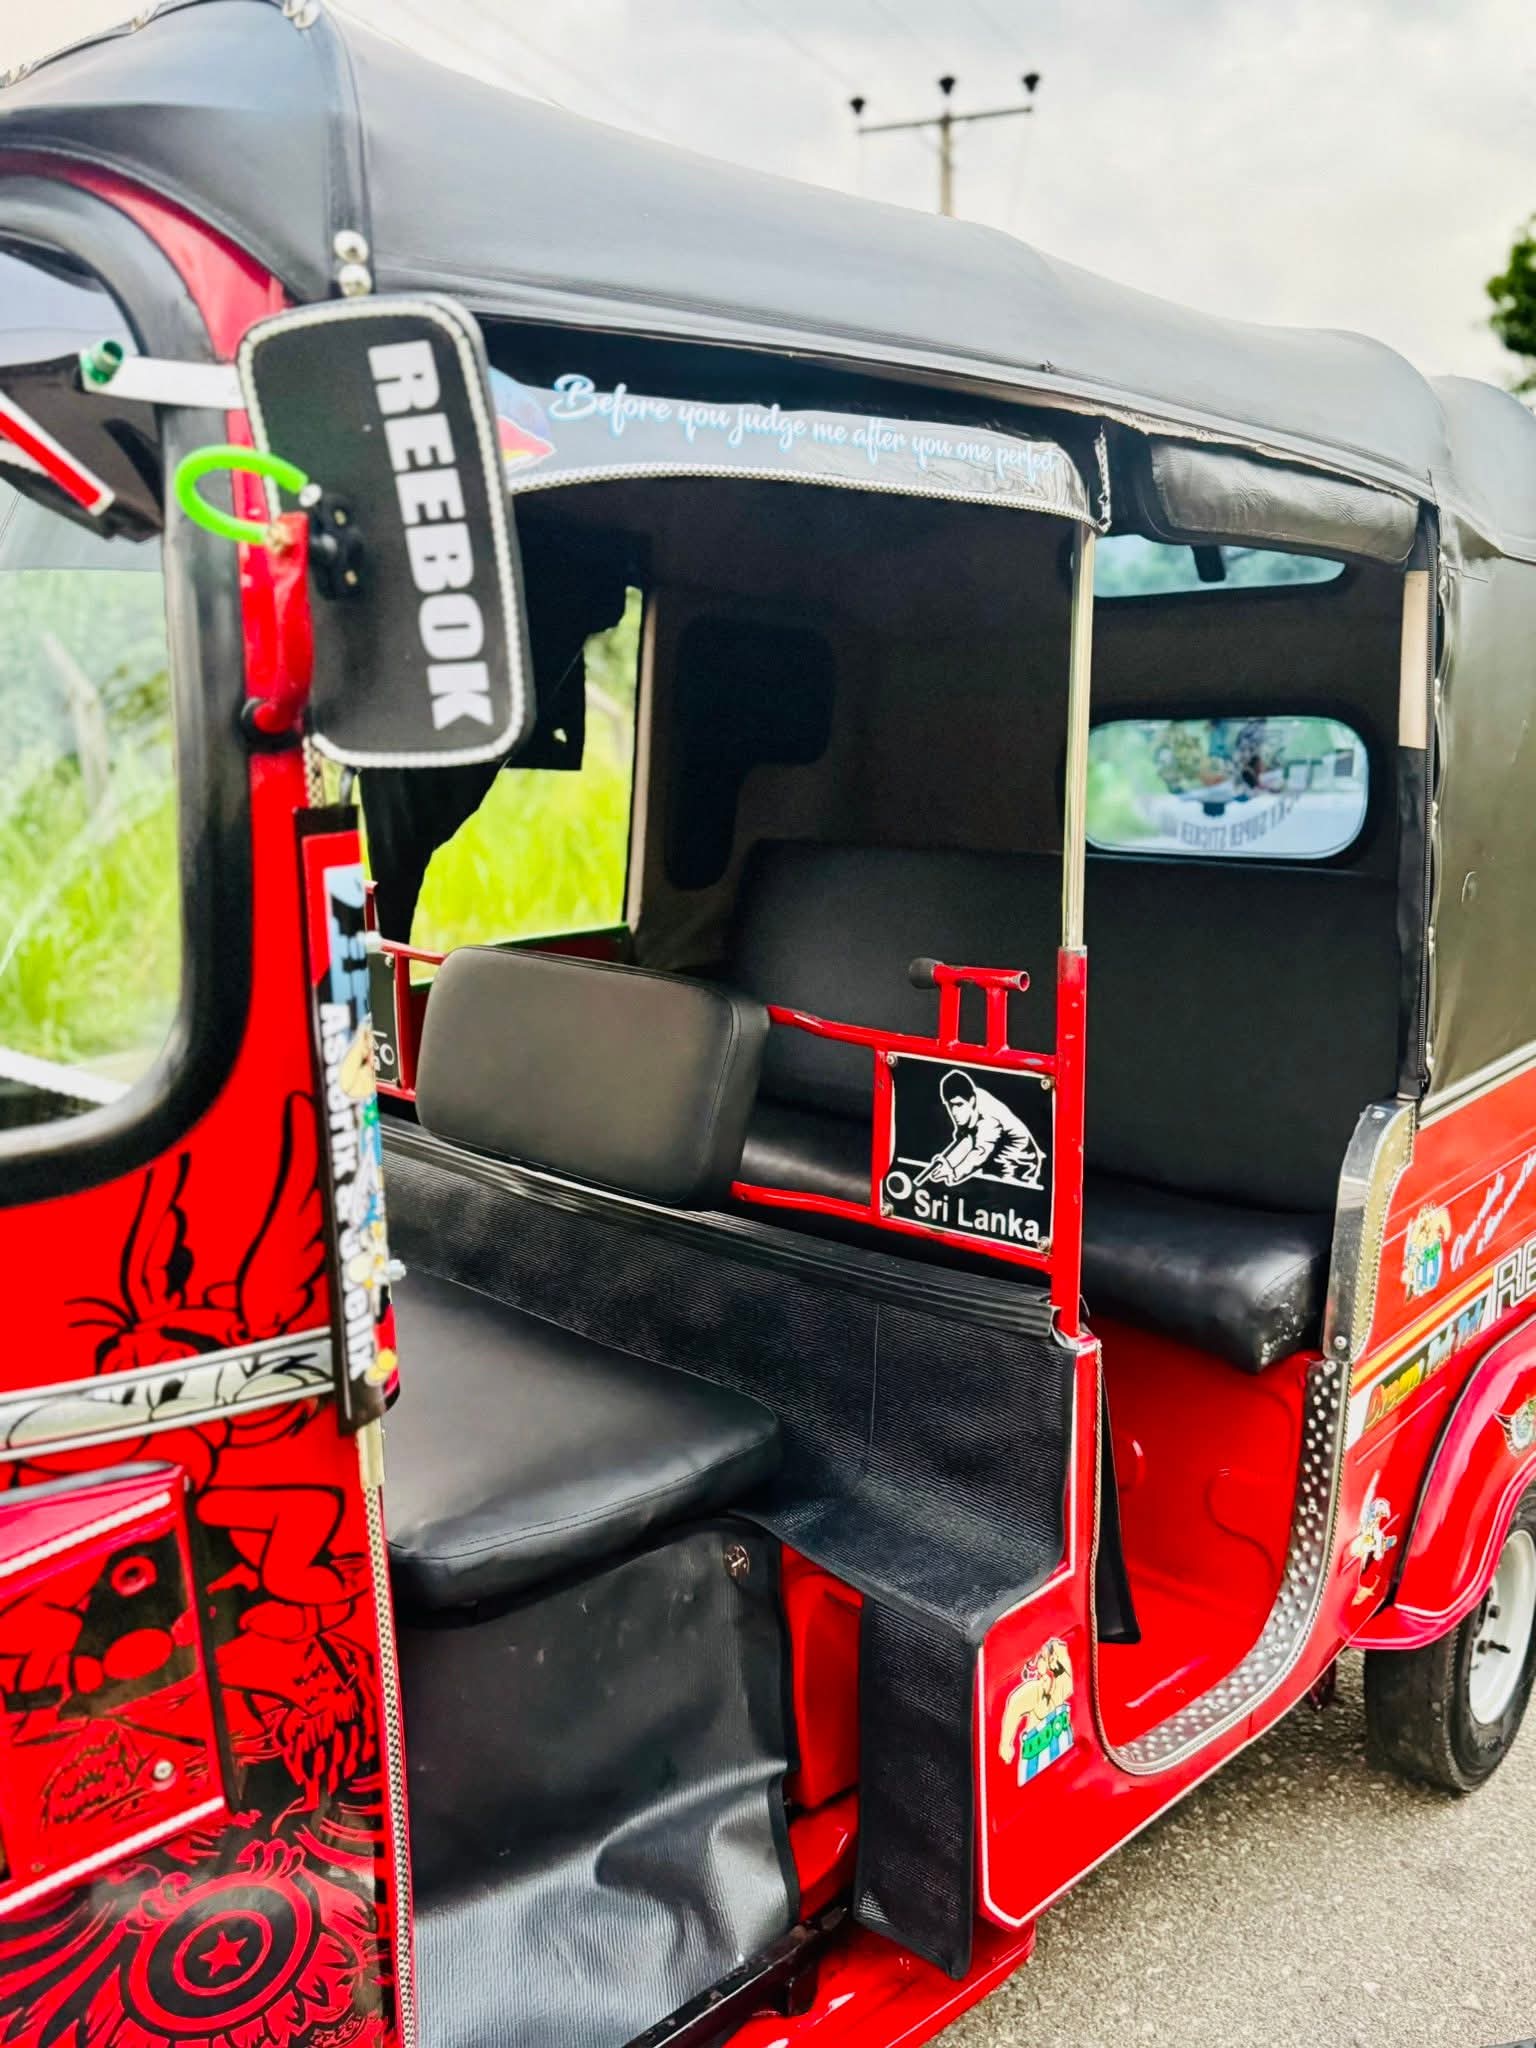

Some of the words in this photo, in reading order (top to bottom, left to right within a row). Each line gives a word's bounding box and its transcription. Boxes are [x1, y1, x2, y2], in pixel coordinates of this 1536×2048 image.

[549, 373, 673, 437] Before
[676, 406, 731, 444] you
[728, 403, 808, 453] judge
[812, 419, 849, 445] me
[852, 416, 906, 466] after
[910, 435, 954, 472] you
[956, 441, 993, 465] one
[992, 442, 1061, 485] perfect
[367, 339, 494, 731] REEBOK
[914, 1188, 949, 1222] Sri
[957, 1198, 1040, 1243] Lanka
